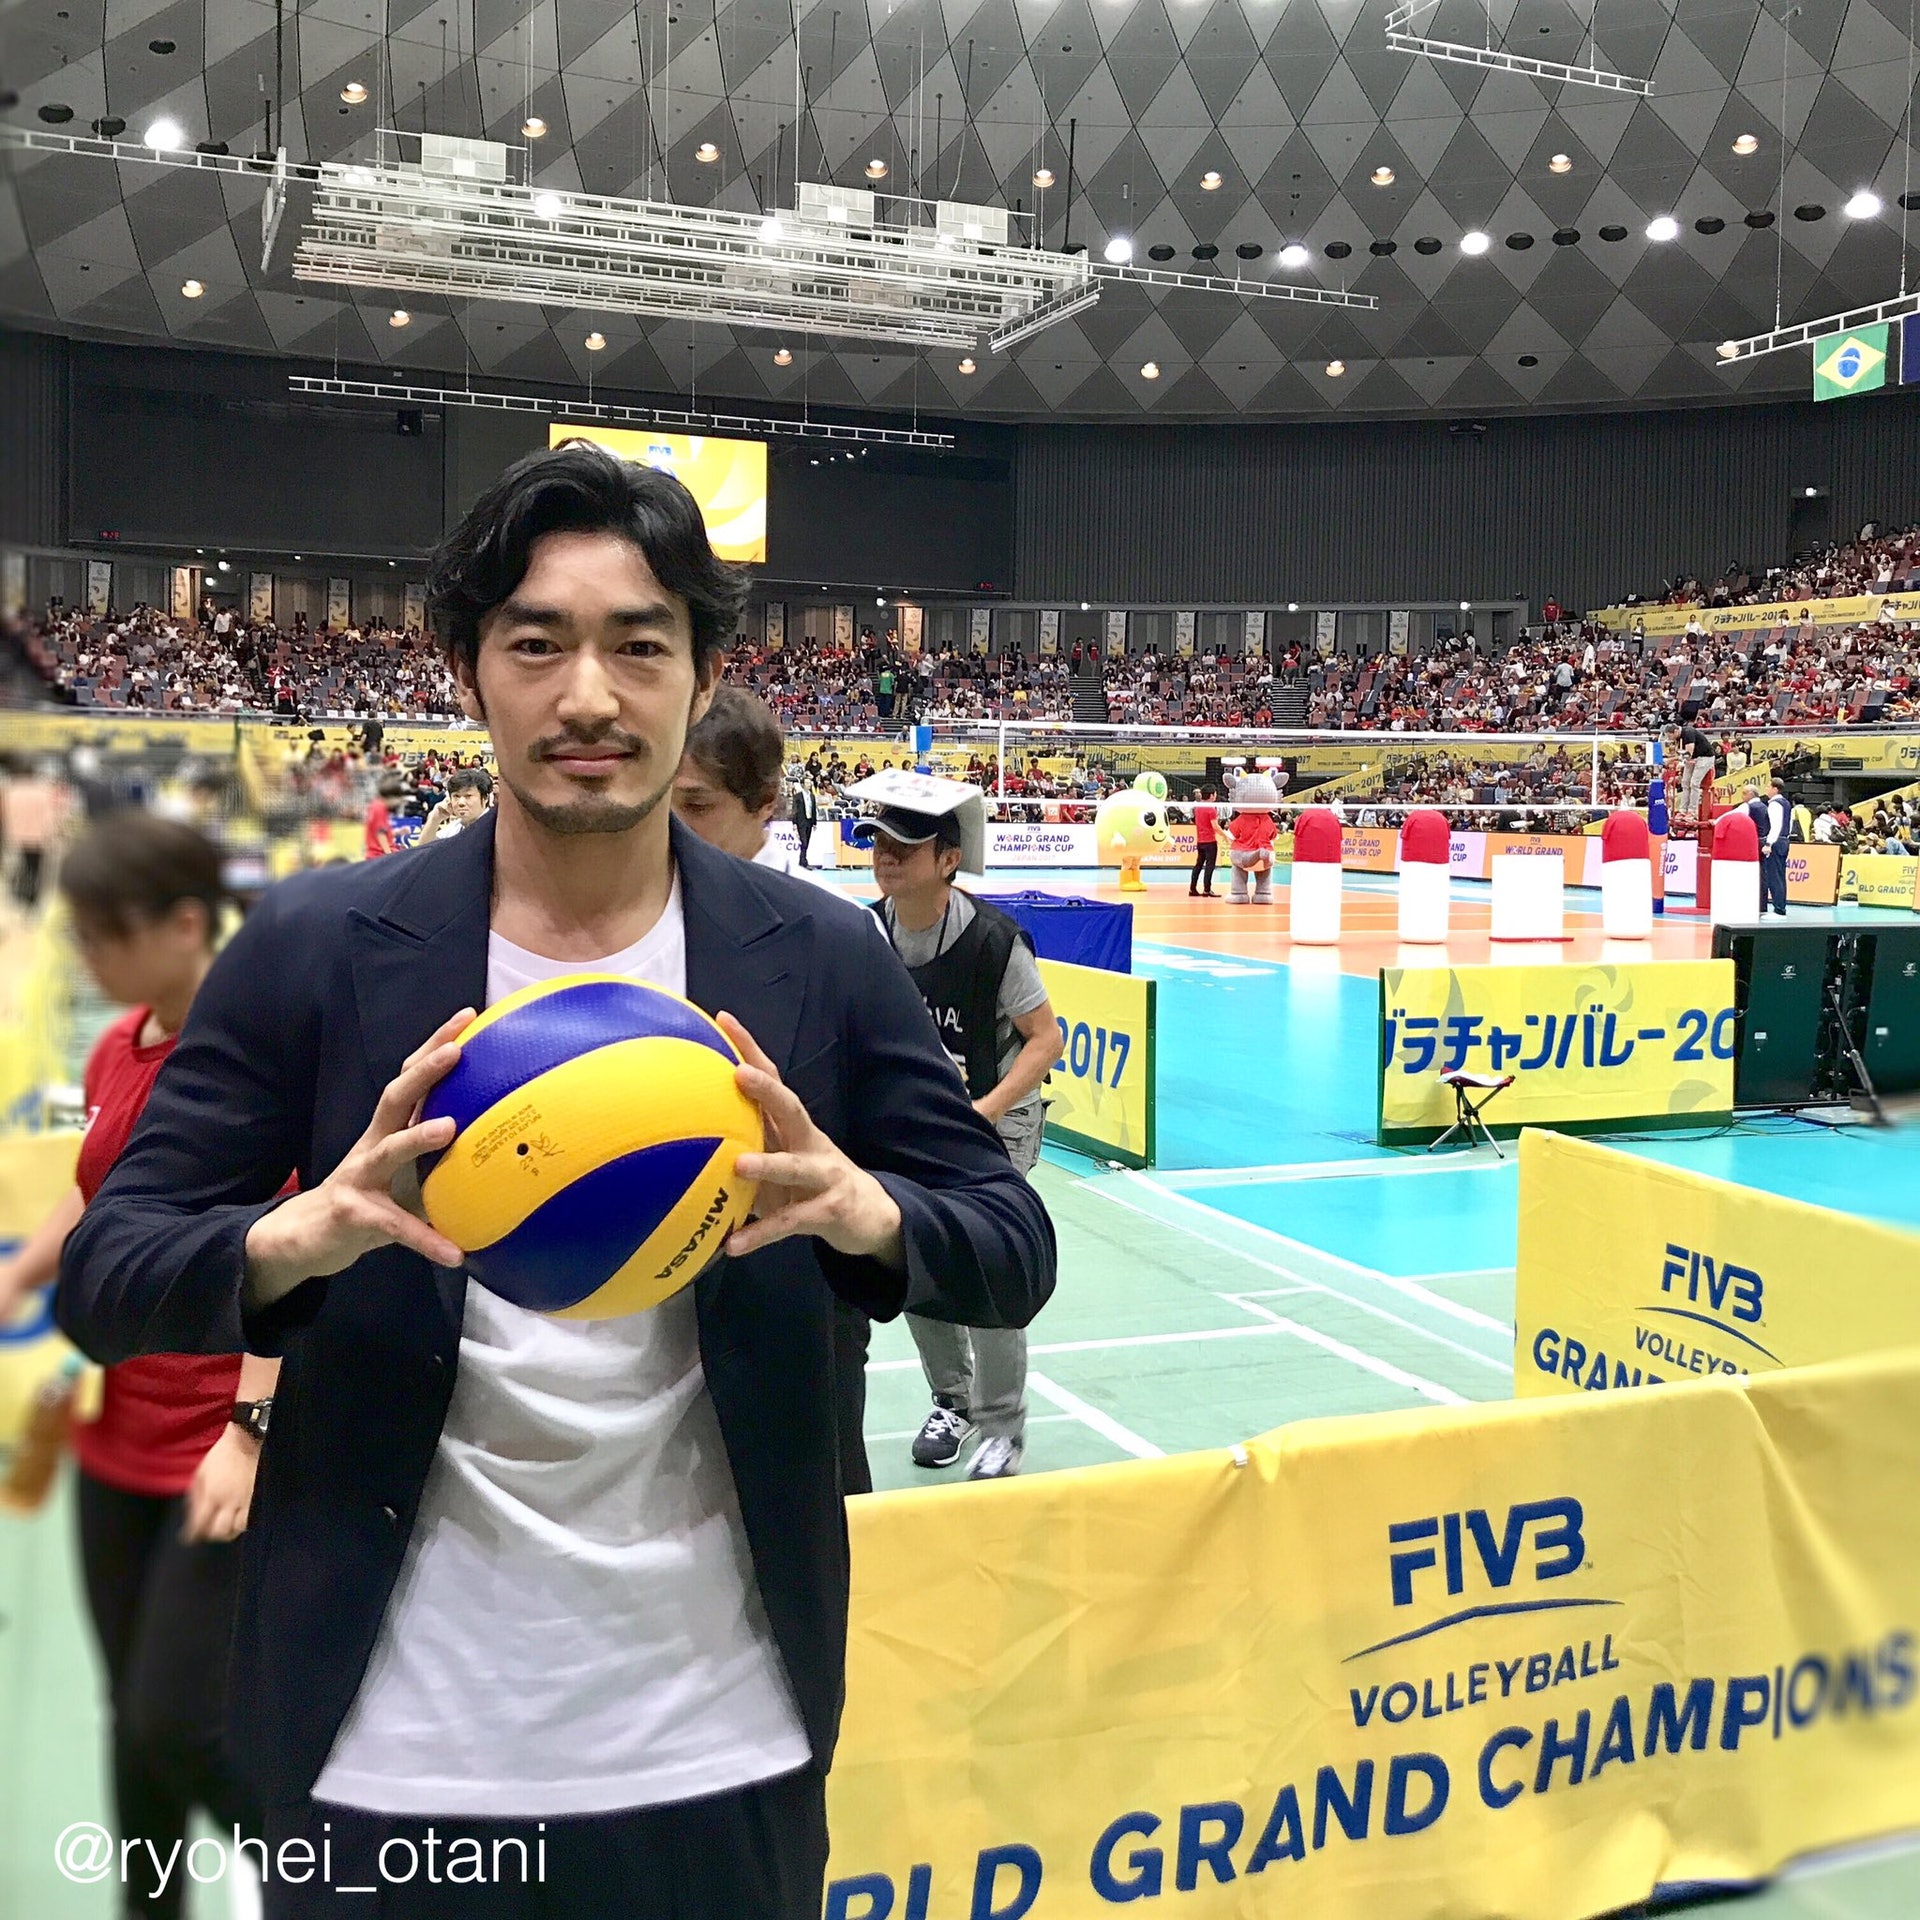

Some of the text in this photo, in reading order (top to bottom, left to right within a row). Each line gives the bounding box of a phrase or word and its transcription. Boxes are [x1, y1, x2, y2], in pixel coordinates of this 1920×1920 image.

[1113, 752, 1138, 761] 2017
[1361, 773, 1381, 788] 2017
[996, 834, 1070, 843] WORLD GRAND
[993, 843, 1074, 852] CHAMPIONS CUP
[1359, 839, 1381, 848] GRAND
[1179, 844, 1198, 853] CUP
[1368, 849, 1382, 857] CUP
[1535, 847, 1564, 856] GRAND
[1452, 853, 1468, 862] CUP
[1788, 871, 1810, 882] CUP
[1878, 885, 1907, 895] GRAND
[1661, 1243, 1764, 1323] FIVB
[1532, 1328, 1666, 1391] GRAN
[1388, 1496, 1586, 1607] FIVB
[1348, 1633, 1621, 1727] VOLLEYBALL
[1089, 1751, 1450, 1904] GRAND
[1477, 1627, 1918, 1810] CHAMPIONS
